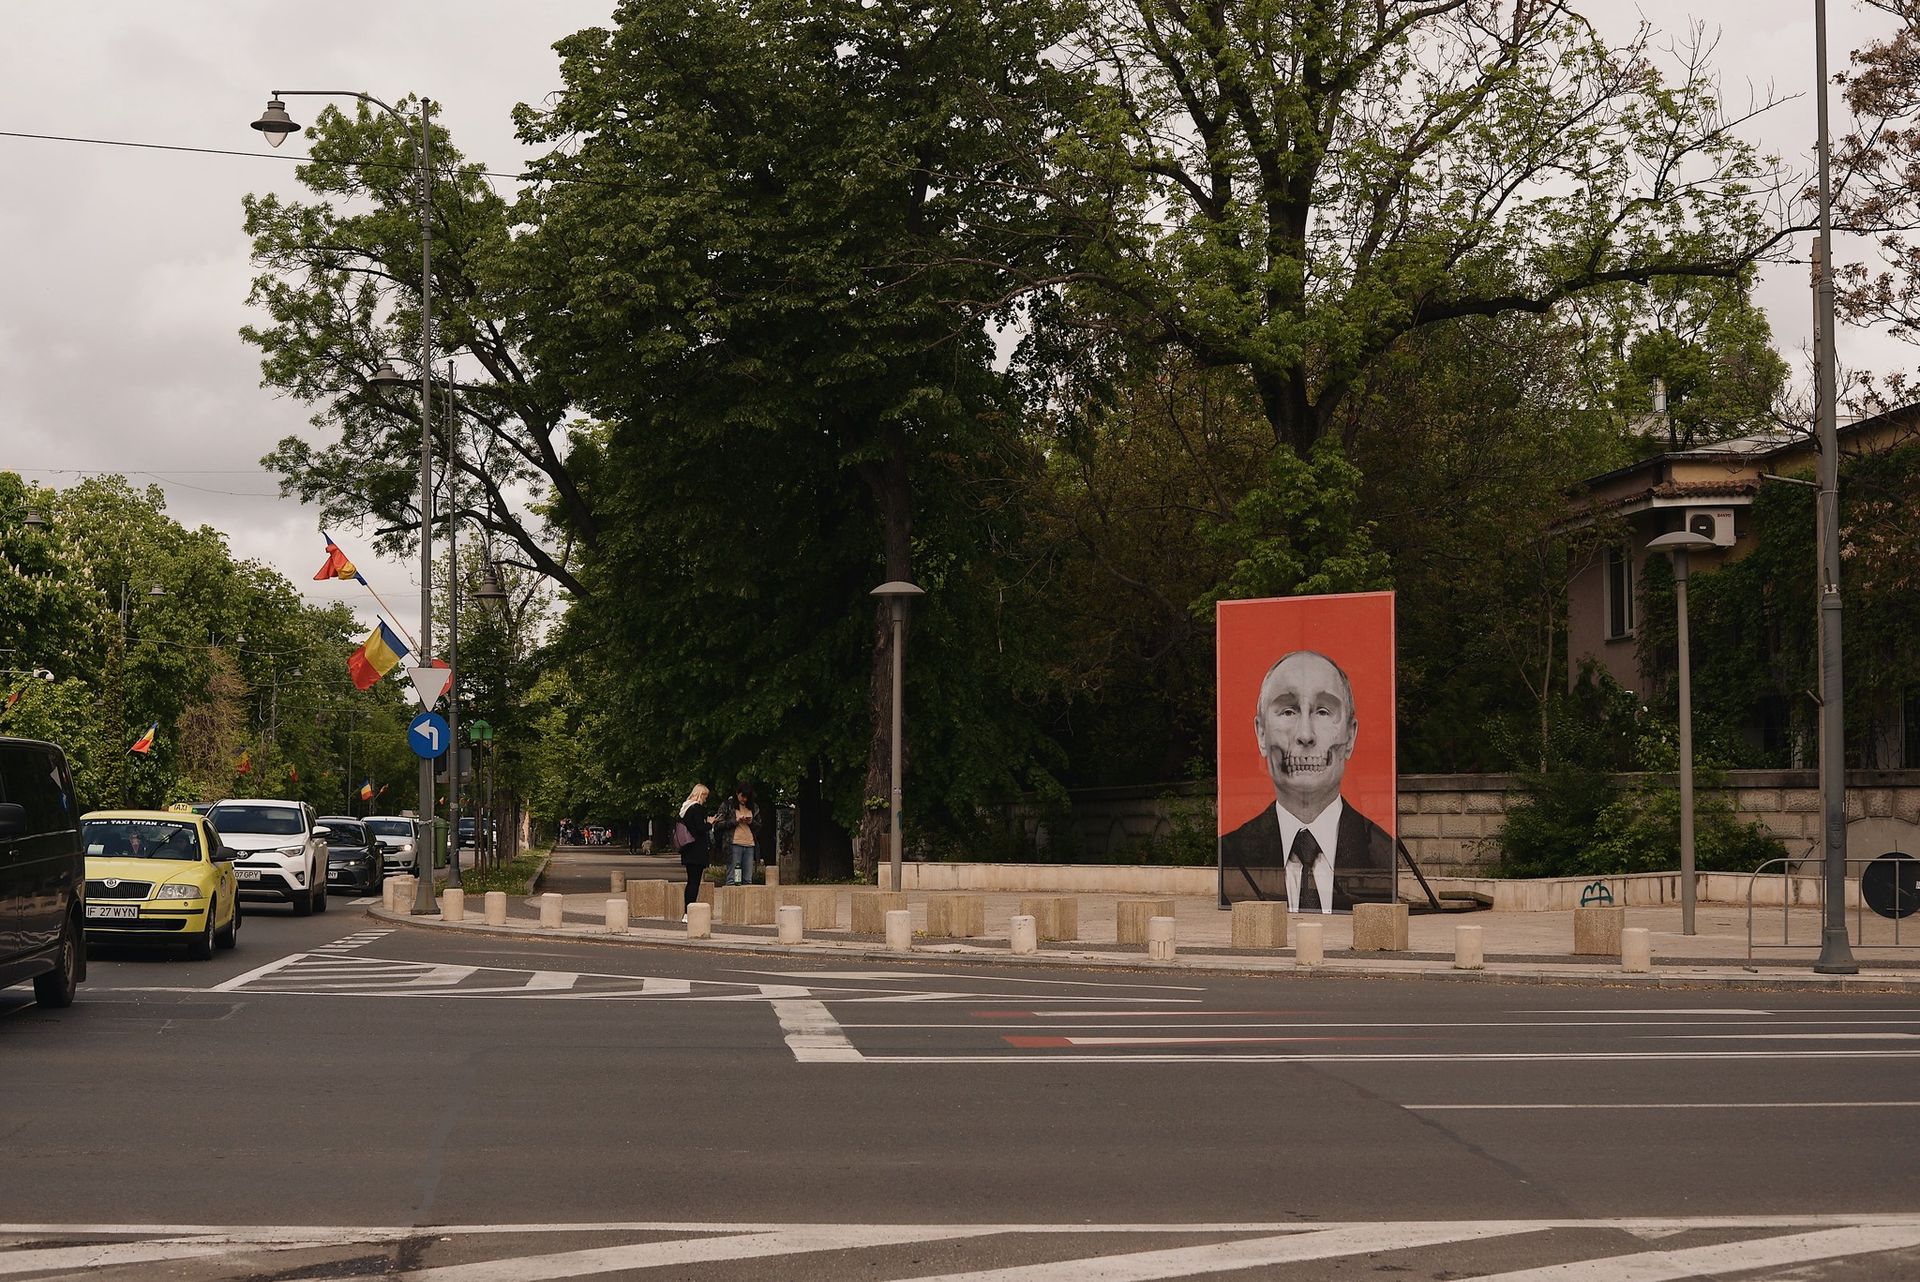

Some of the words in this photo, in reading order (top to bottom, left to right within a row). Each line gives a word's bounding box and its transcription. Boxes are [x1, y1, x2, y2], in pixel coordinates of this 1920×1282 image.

[88, 906, 97, 916] IF
[100, 907, 111, 917] 27
[113, 907, 136, 917] WYN
